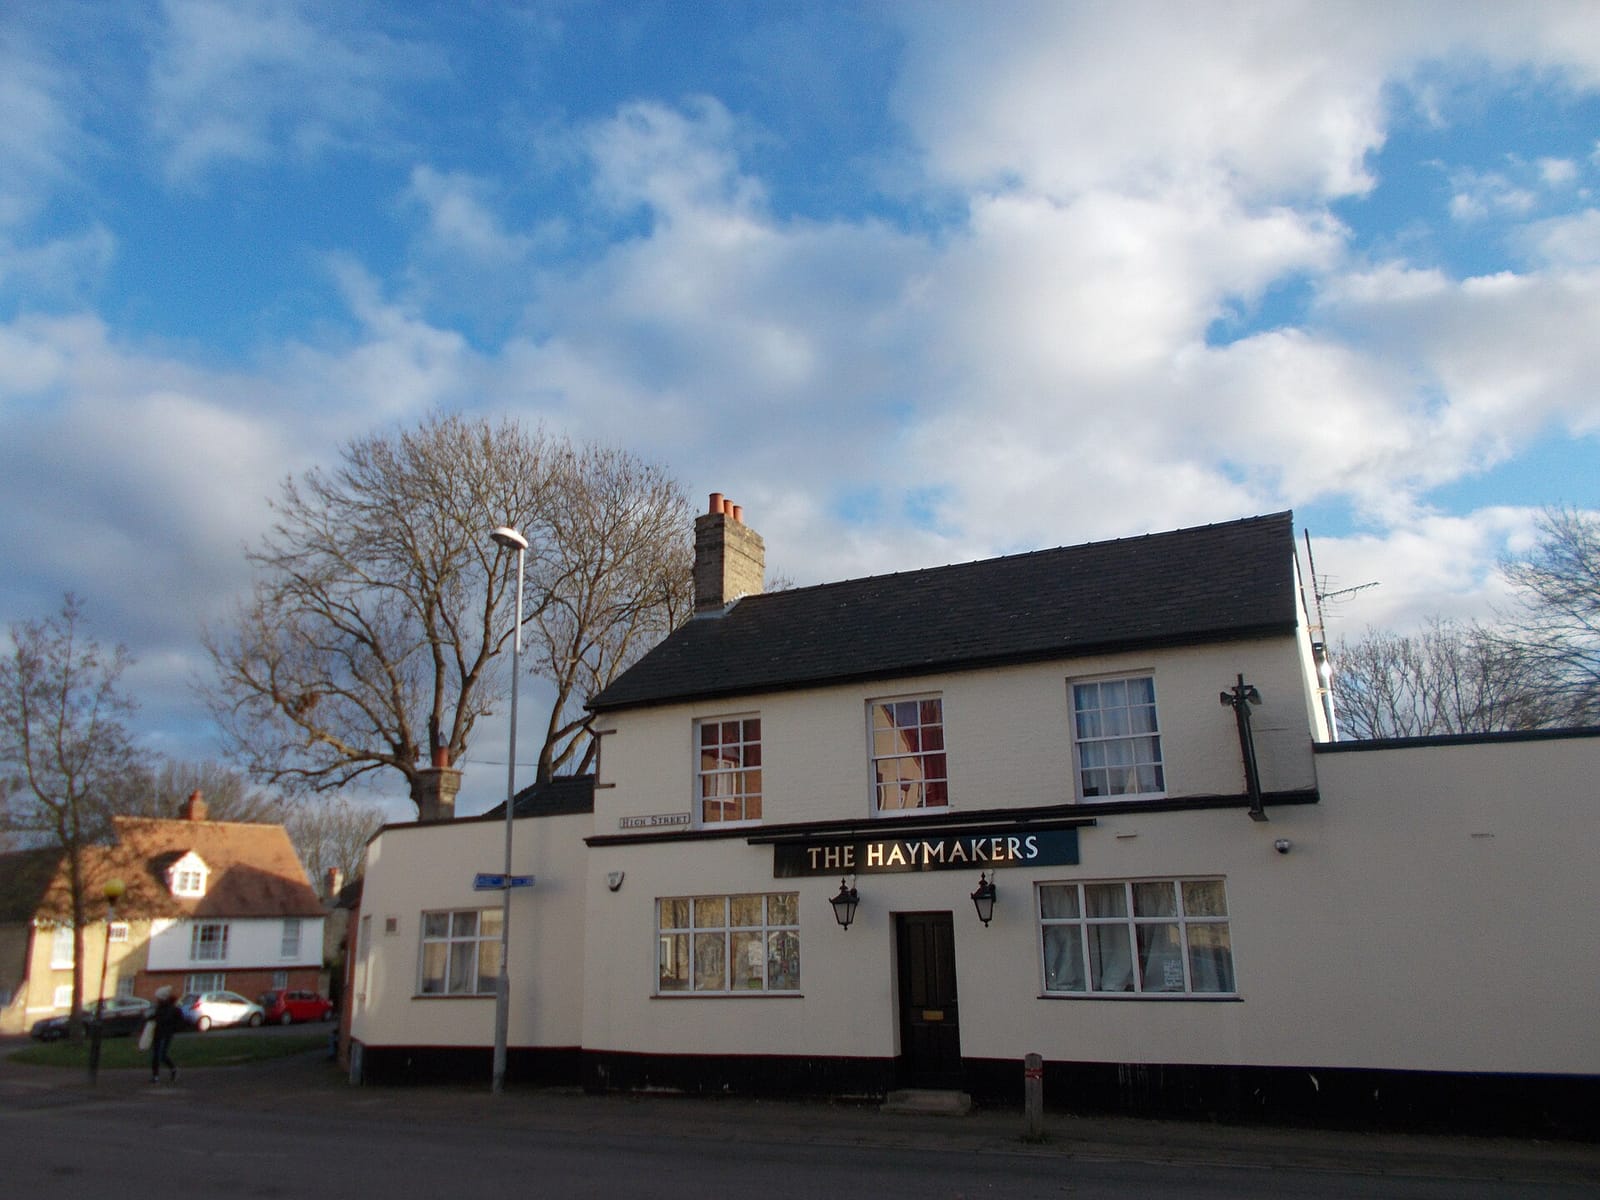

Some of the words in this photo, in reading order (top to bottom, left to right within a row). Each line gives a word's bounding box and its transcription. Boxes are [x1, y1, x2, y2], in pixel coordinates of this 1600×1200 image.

[623, 817, 646, 828] HIGH
[651, 815, 687, 826] STREET
[807, 845, 855, 869] THE
[866, 835, 1039, 867] HAYMAKERS
